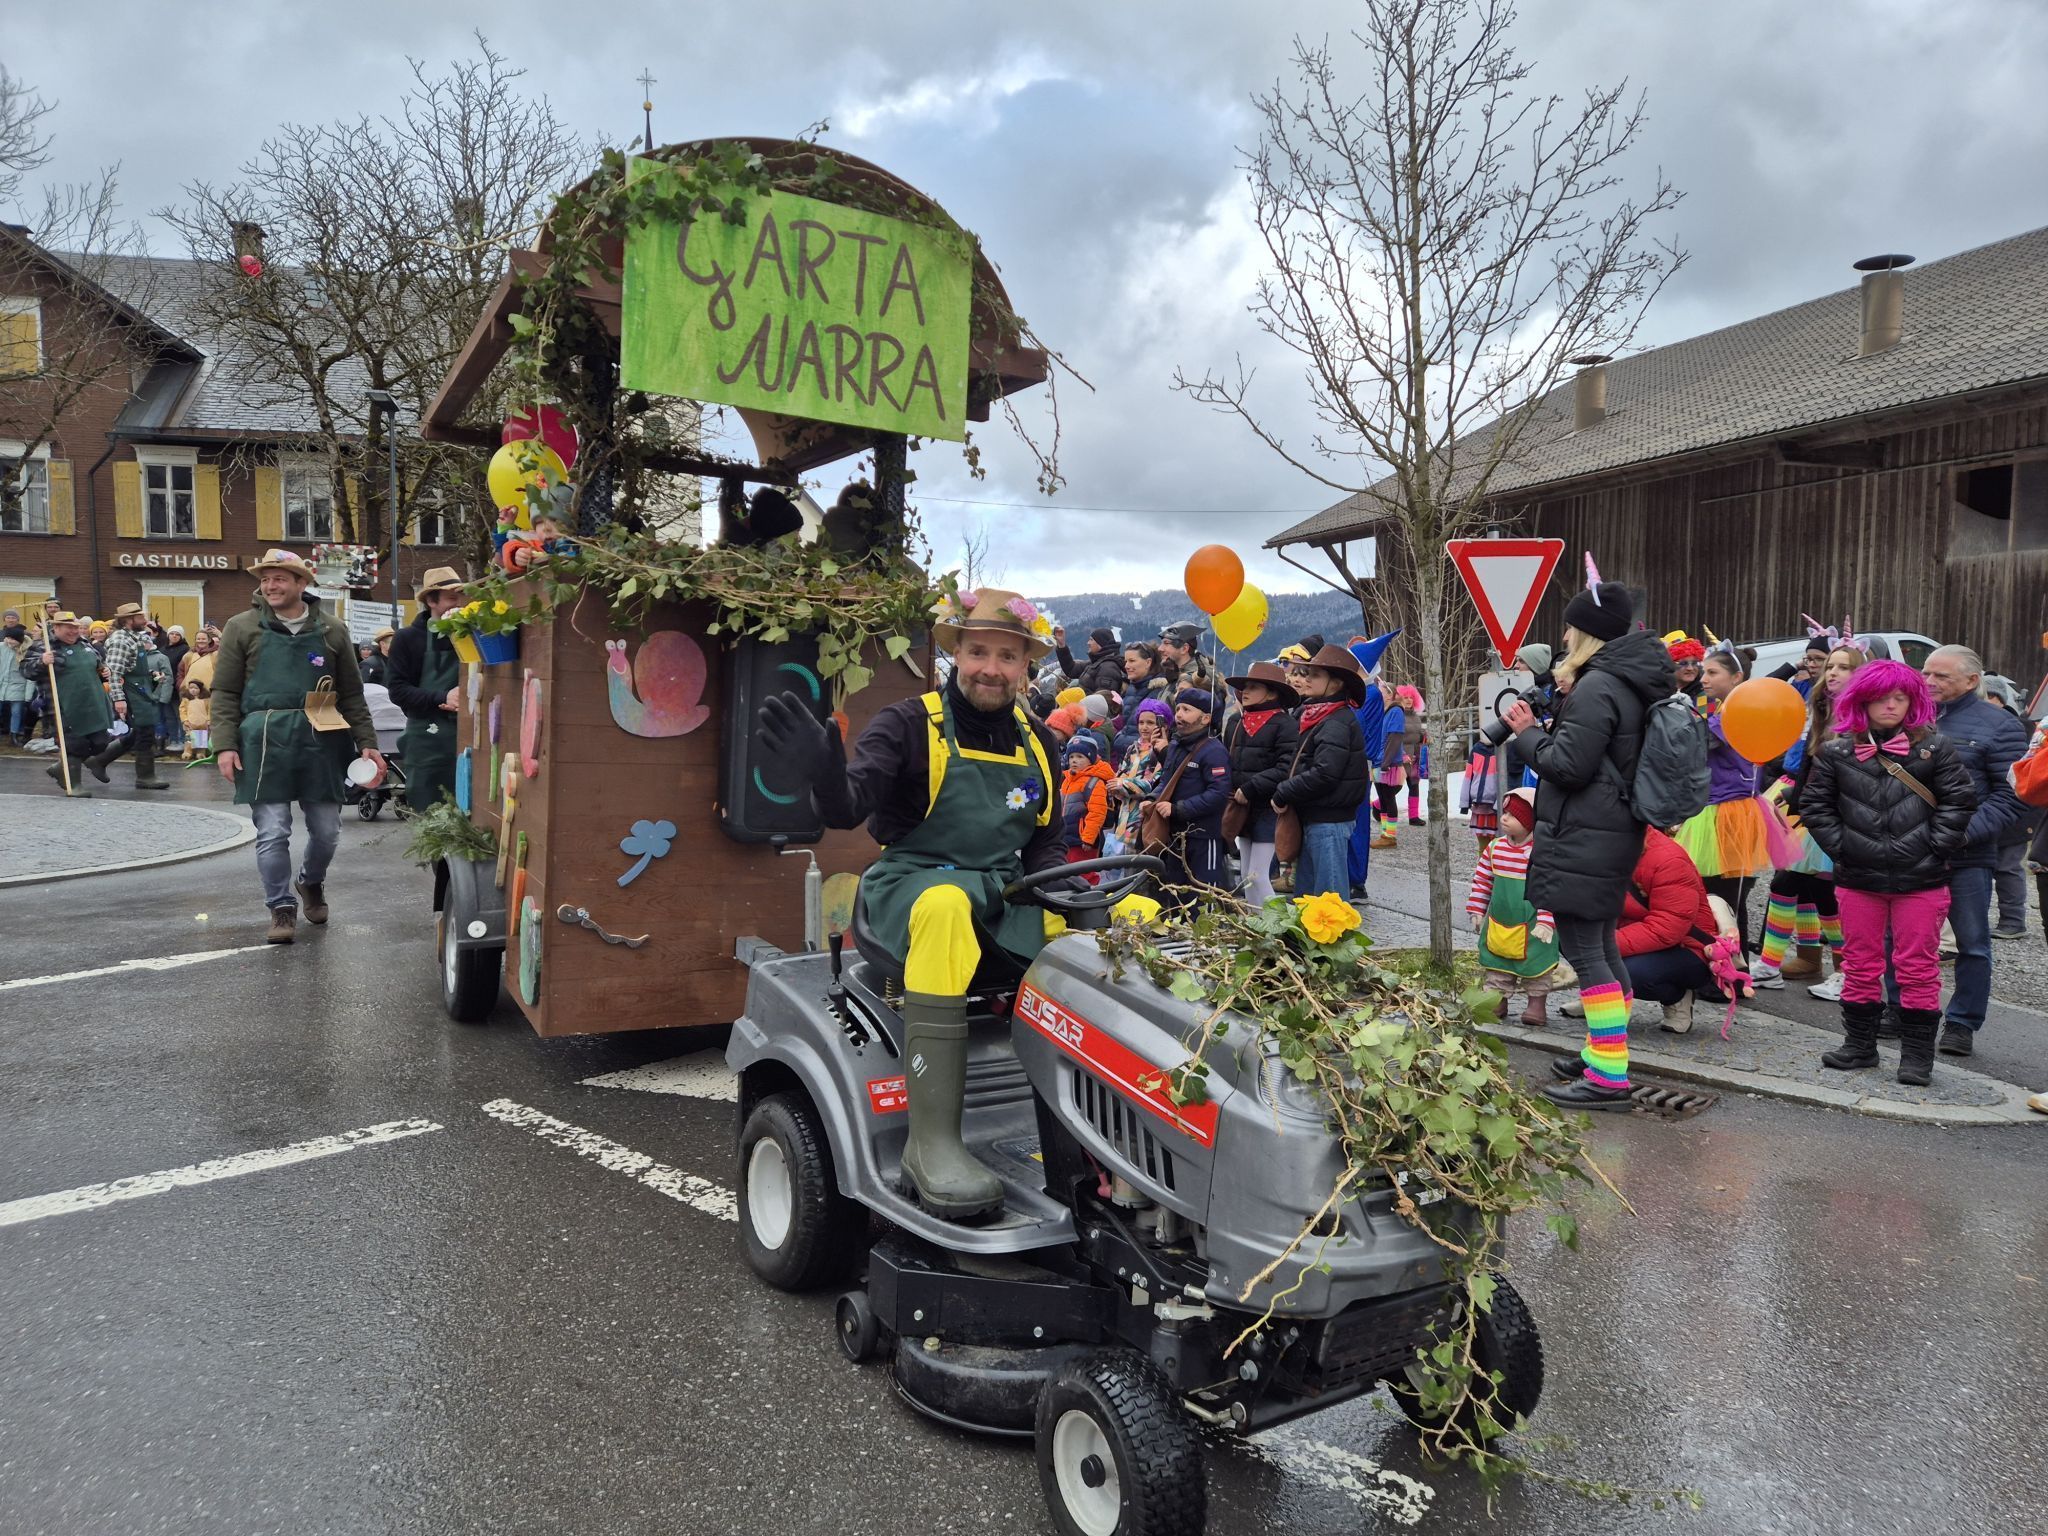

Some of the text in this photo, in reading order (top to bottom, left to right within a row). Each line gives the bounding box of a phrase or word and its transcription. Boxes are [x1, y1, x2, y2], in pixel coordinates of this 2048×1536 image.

[677, 194, 925, 331] GARTA
[716, 313, 946, 421] NARRA
[119, 553, 229, 569] GASTHAUS
[1020, 987, 1084, 1049] BLISAR
[879, 1097, 895, 1106] GE
